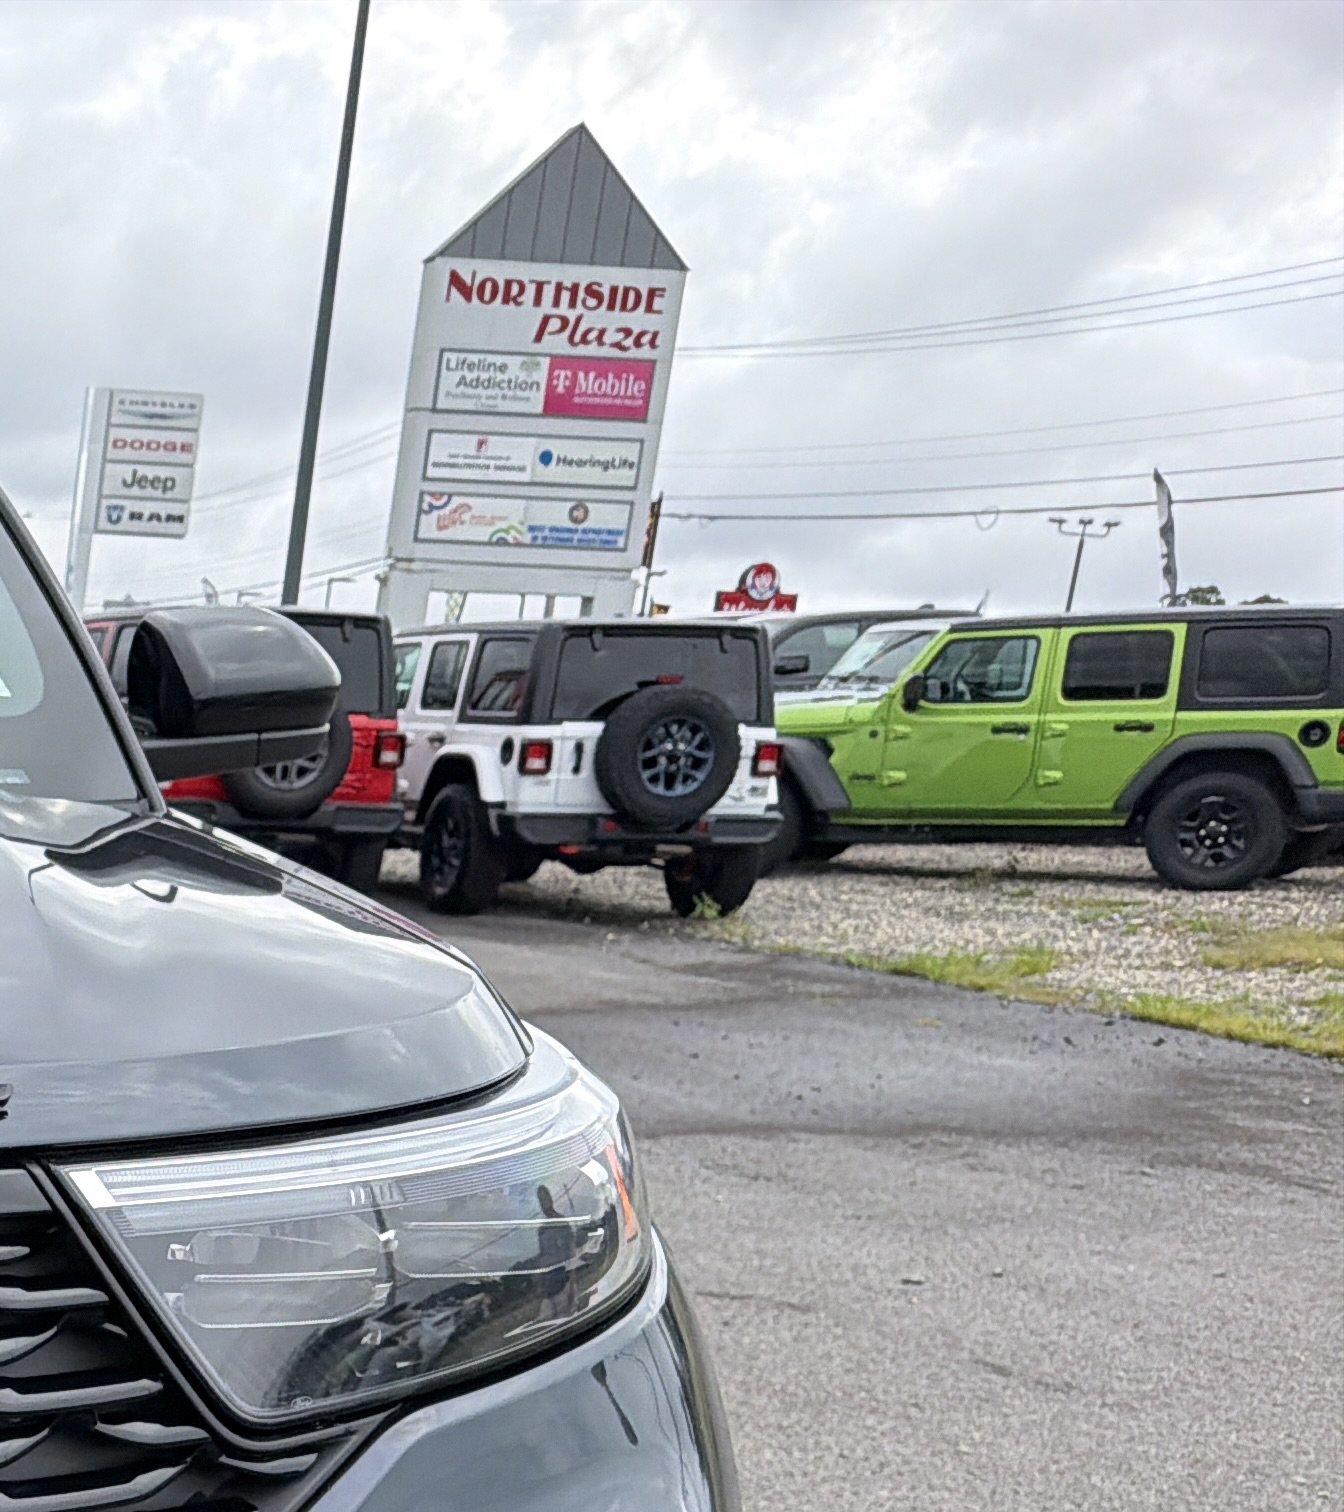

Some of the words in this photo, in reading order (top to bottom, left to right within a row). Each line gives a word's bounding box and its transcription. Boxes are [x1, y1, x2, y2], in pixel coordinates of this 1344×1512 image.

[445, 269, 667, 315] NORTHSIDE
[532, 313, 661, 352] Plaza
[445, 356, 509, 375] Lifeline
[455, 374, 541, 392] Addiction
[573, 370, 646, 399] Mobile
[112, 437, 194, 454] DODGE
[122, 468, 177, 494] Jeep
[128, 511, 185, 525] RAM
